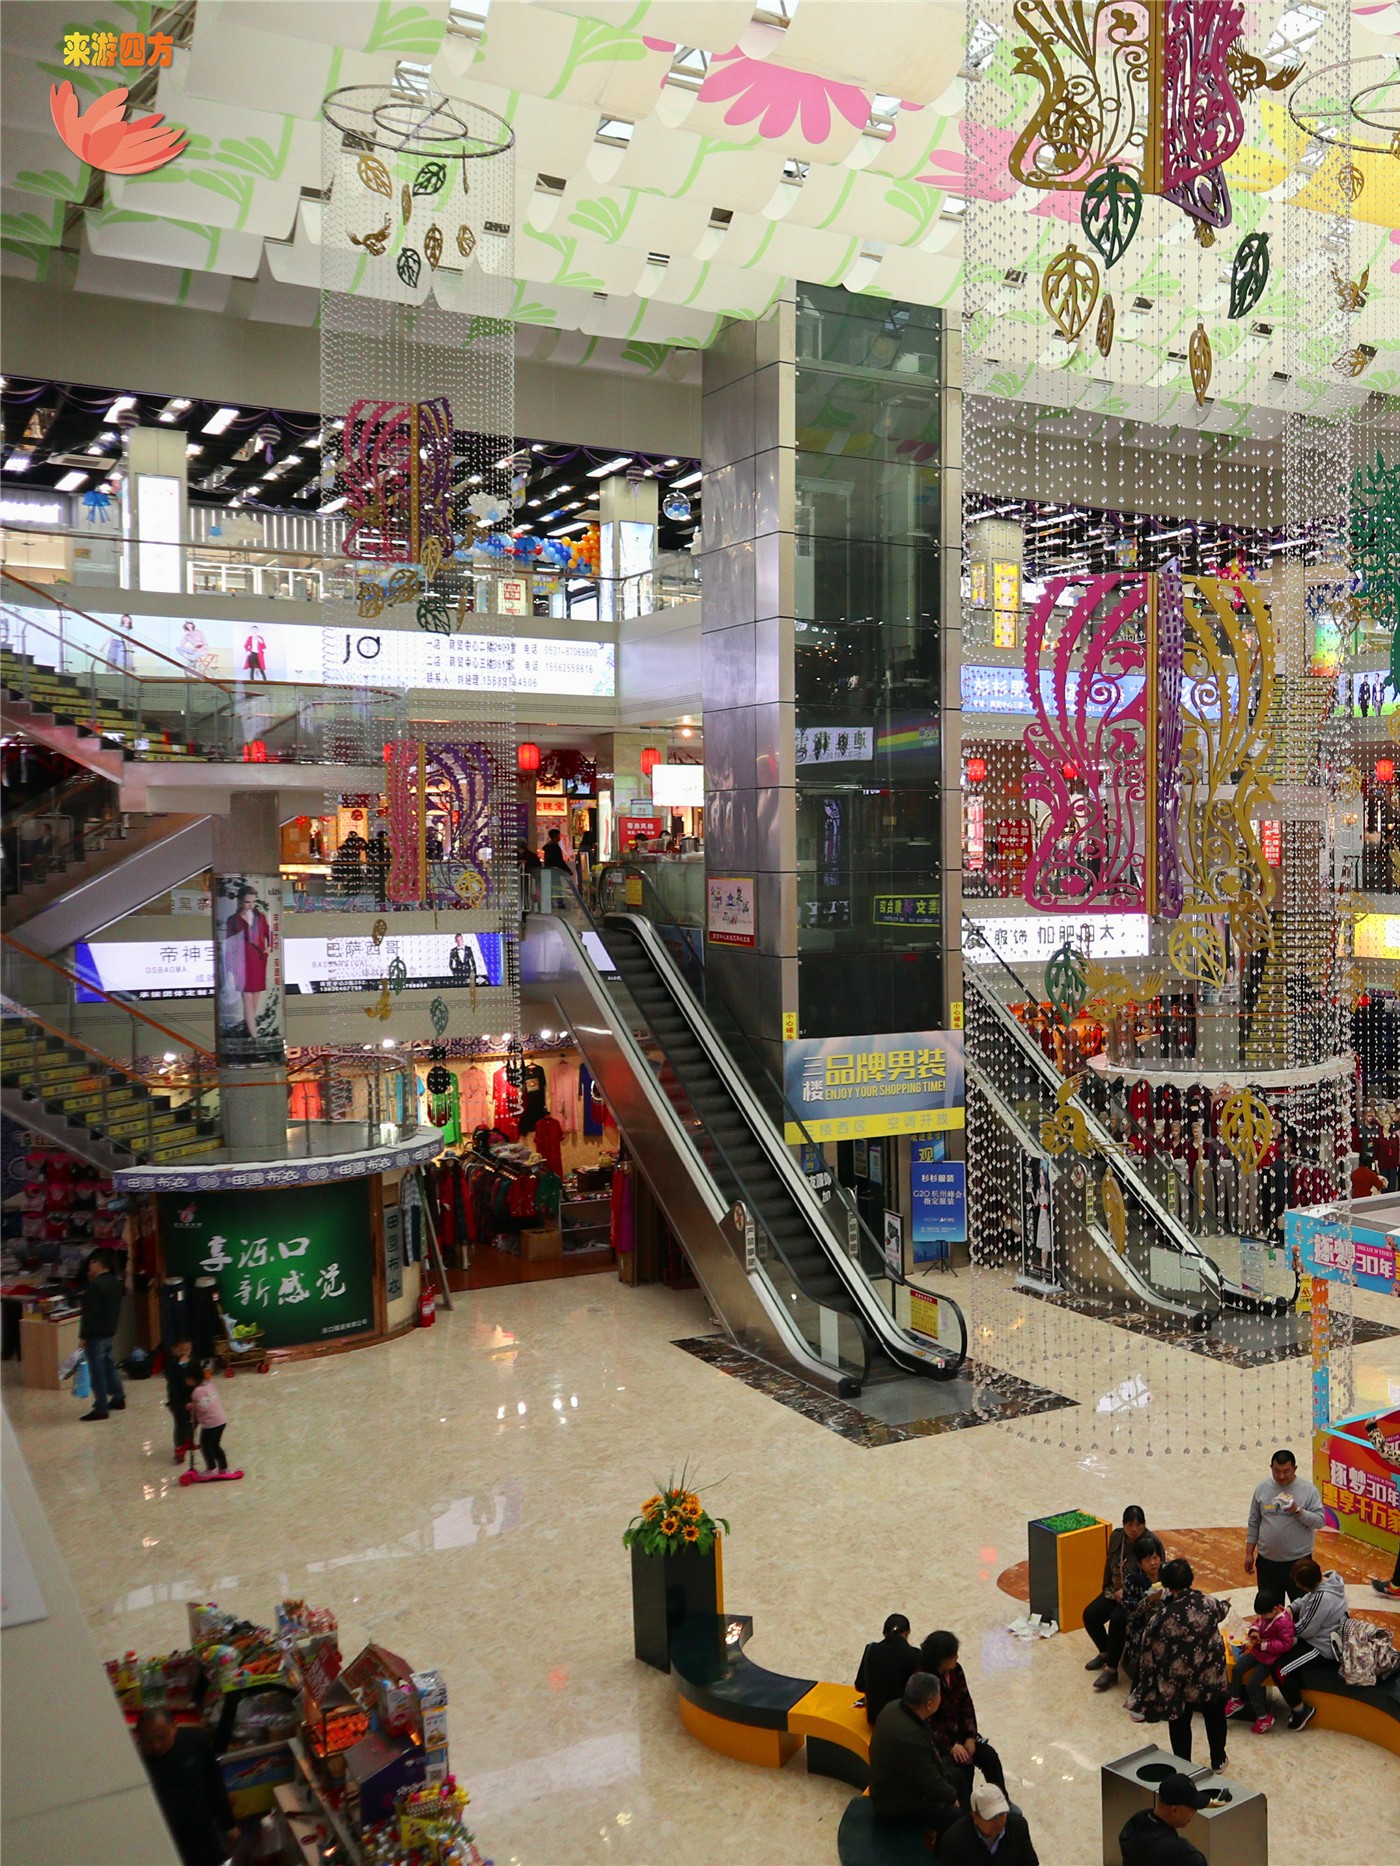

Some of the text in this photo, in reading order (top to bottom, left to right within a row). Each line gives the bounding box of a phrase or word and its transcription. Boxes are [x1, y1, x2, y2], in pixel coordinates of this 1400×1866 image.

[825, 1048, 946, 1086] 品牌男装
[825, 1080, 946, 1101] ENJOY YOUR SHOPPING TIME!
[802, 1111, 948, 1138] 三楼西区 空调开放
[912, 1189, 963, 1199] G20 杭州峰会
[1330, 1459, 1400, 1508] 逐梦30年
